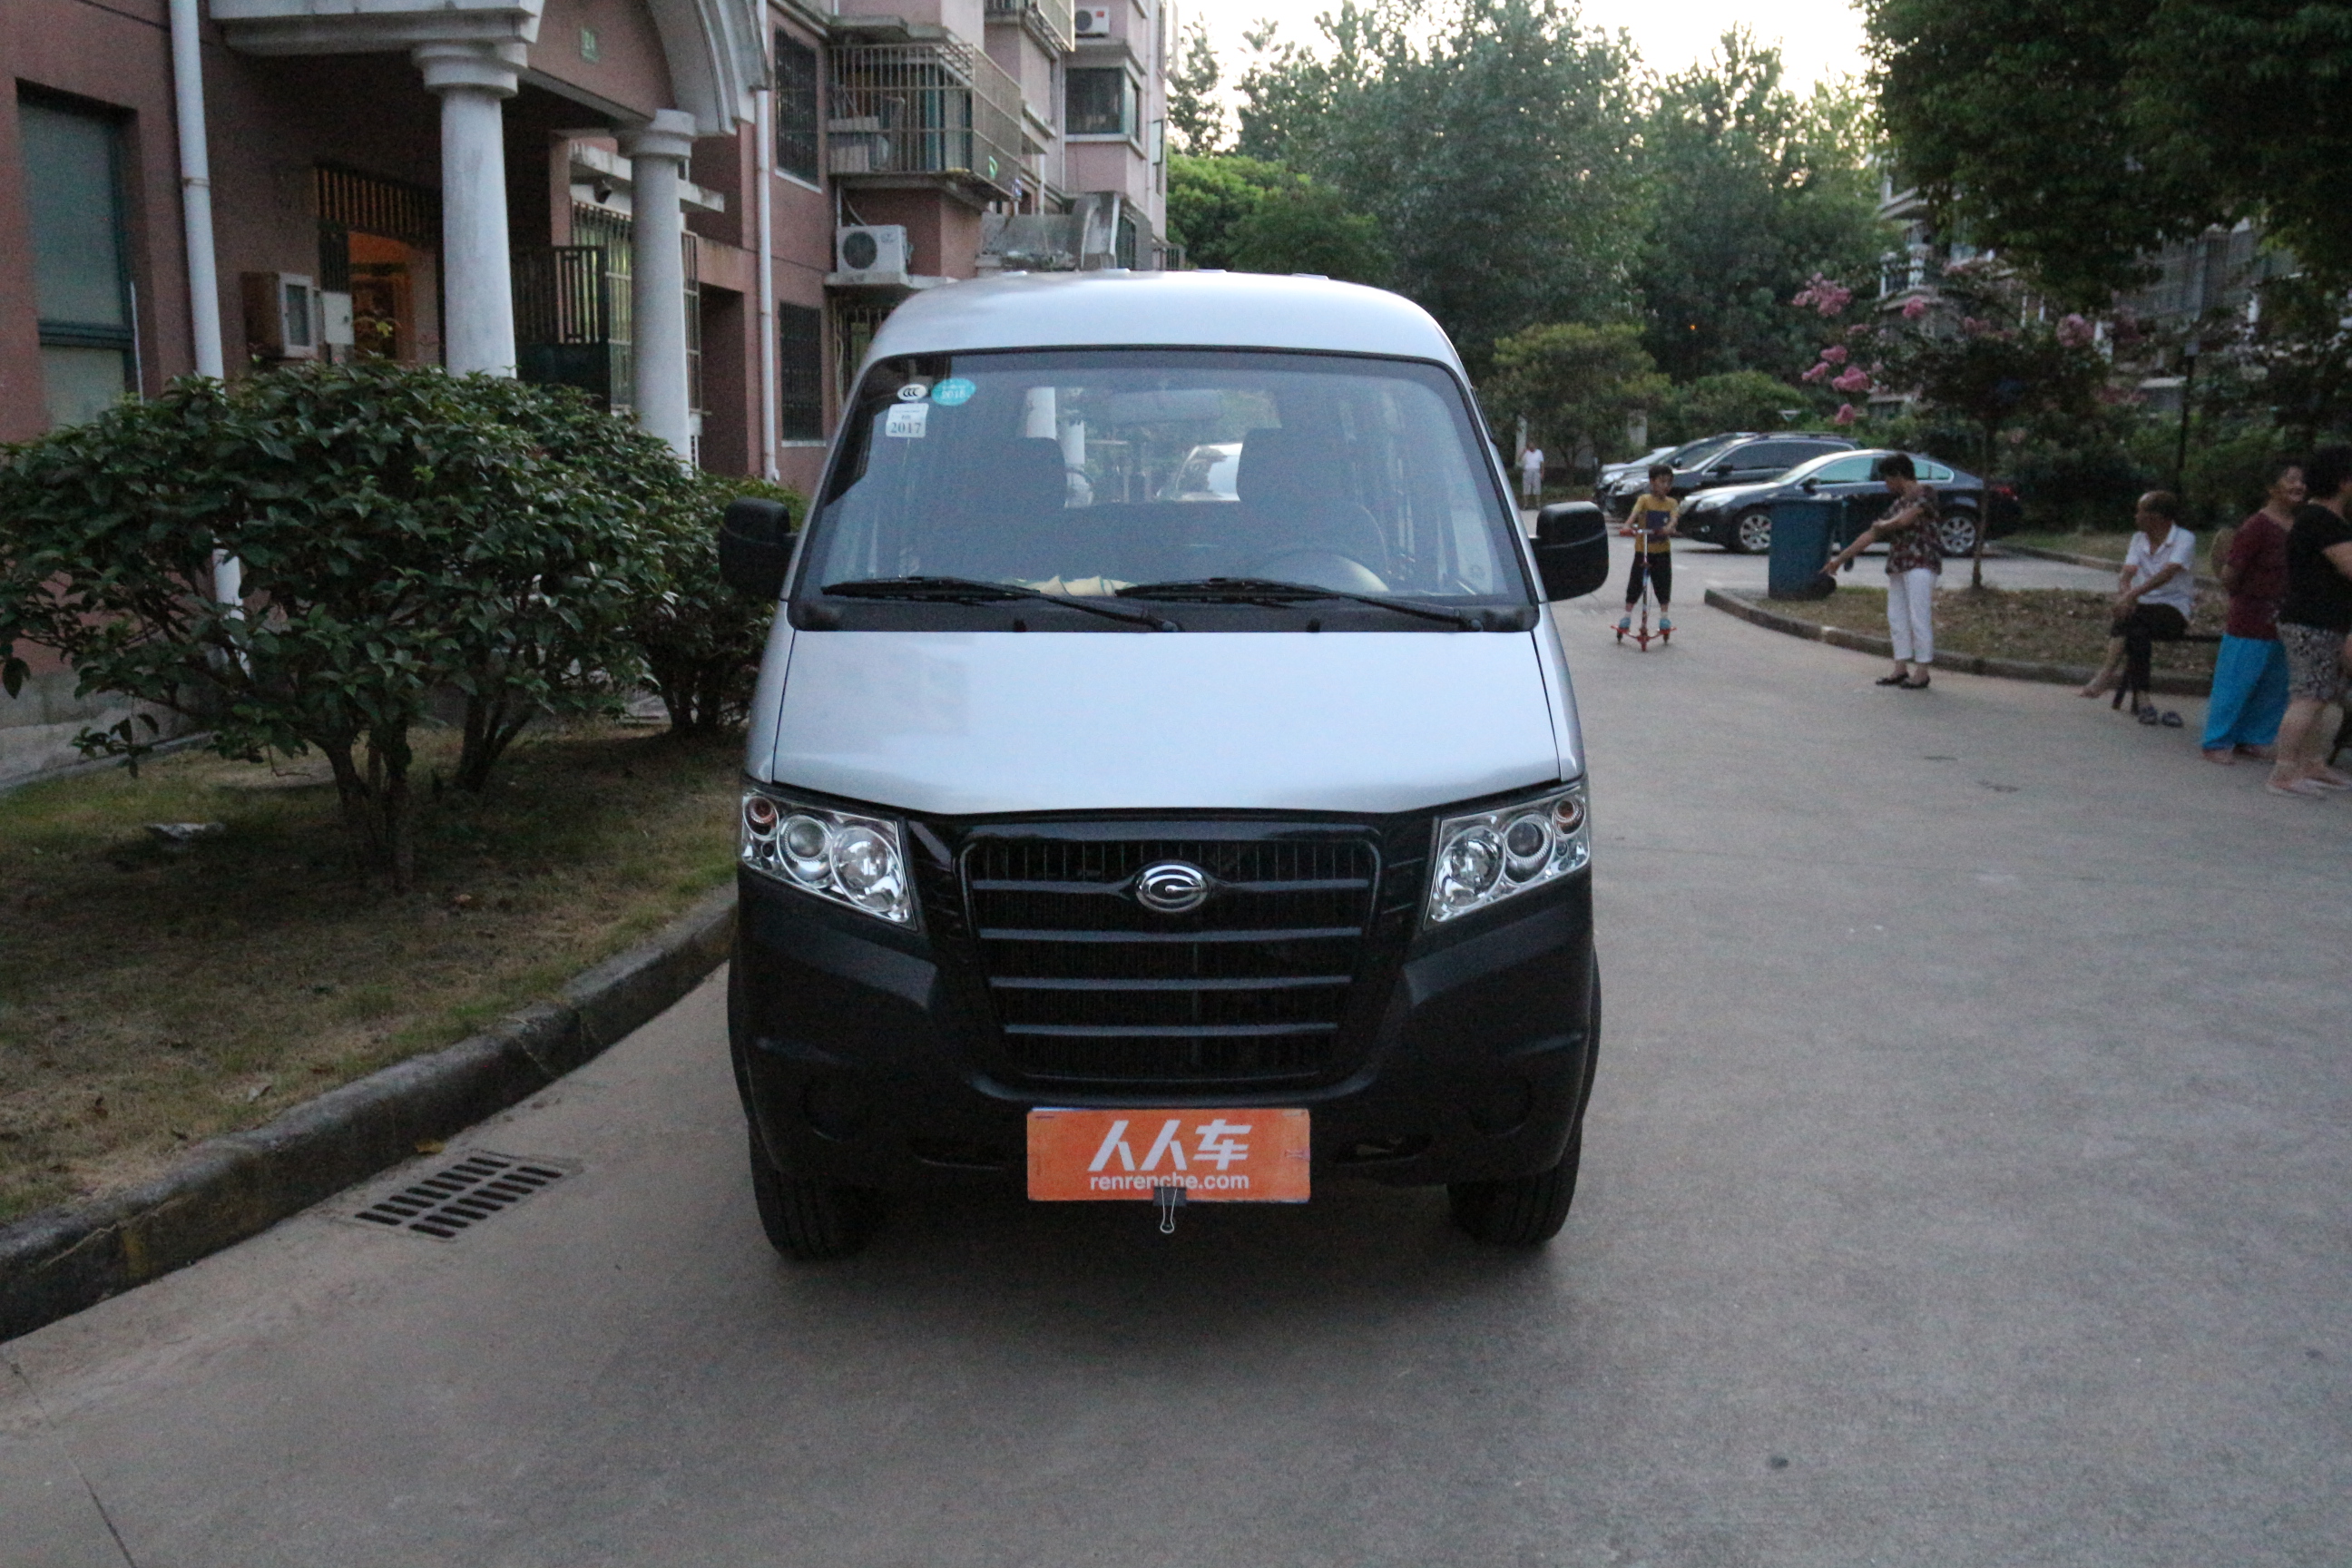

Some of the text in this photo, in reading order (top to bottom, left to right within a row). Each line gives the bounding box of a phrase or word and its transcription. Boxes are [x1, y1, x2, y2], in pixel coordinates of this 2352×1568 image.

[890, 422, 922, 434] 2017
[1087, 1118, 1253, 1172] 人人车
[1090, 1171, 1250, 1191] renrenche.com
